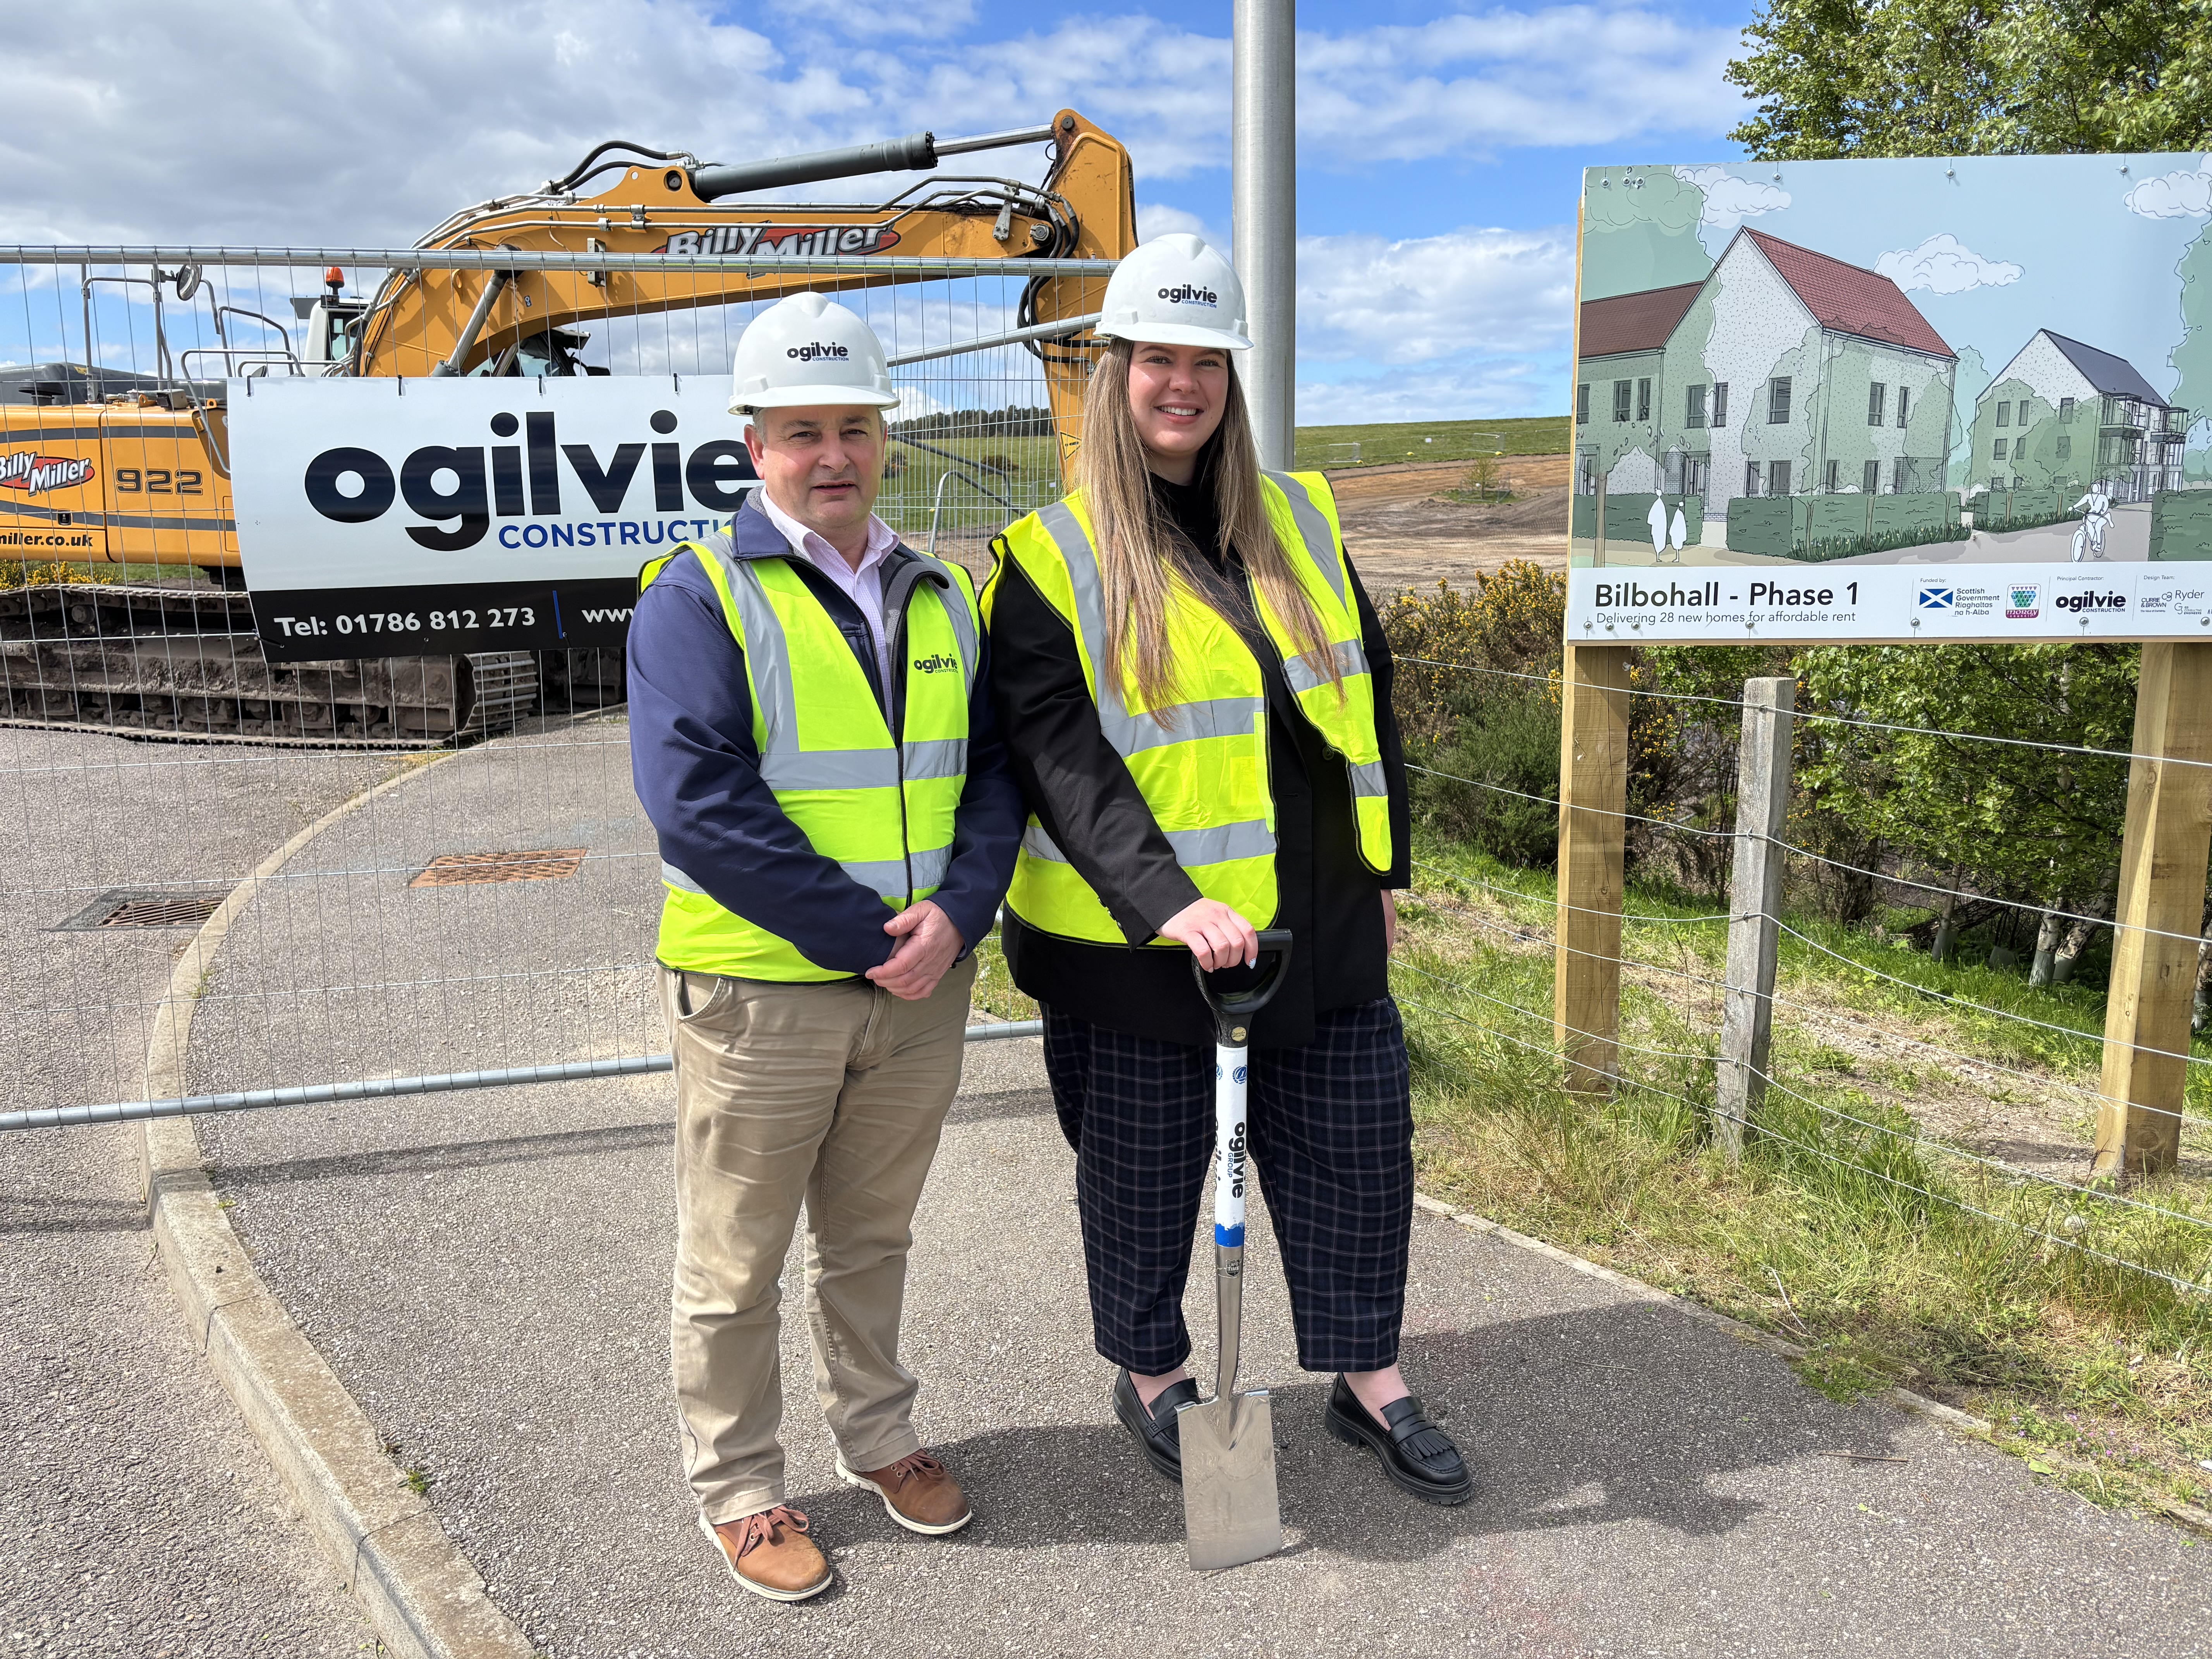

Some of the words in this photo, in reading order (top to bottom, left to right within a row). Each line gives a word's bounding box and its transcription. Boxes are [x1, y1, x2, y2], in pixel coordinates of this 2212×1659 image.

[666, 220, 771, 255] Billy
[1158, 284, 1217, 303] ogilvie
[1182, 300, 1217, 308] CONSTRUCTION
[787, 342, 848, 361] ogilvie
[28, 458, 91, 497] Miller
[116, 468, 203, 495] 922
[305, 410, 764, 551] ogilvie
[499, 519, 731, 549] CONSTRUCTI
[1595, 582, 1719, 607] Bilbohall
[1750, 581, 1833, 606] Phase
[1846, 582, 1857, 605] 1
[2056, 591, 2126, 613] ogilvie
[2175, 589, 2205, 601] Ryder
[274, 617, 327, 636] Tel:
[336, 613, 421, 634] 01786
[430, 610, 479, 630] 812
[488, 607, 535, 627] 273
[582, 608, 634, 623] ww
[1597, 612, 1656, 625] Delivering
[1660, 612, 1674, 622] 28
[1706, 611, 1745, 622] homes
[1748, 611, 1764, 622] for
[1768, 610, 1828, 622] affordable
[1832, 612, 1856, 621] rent
[914, 653, 958, 674] ogilvie
[1229, 1122, 1246, 1198] ogilvie
